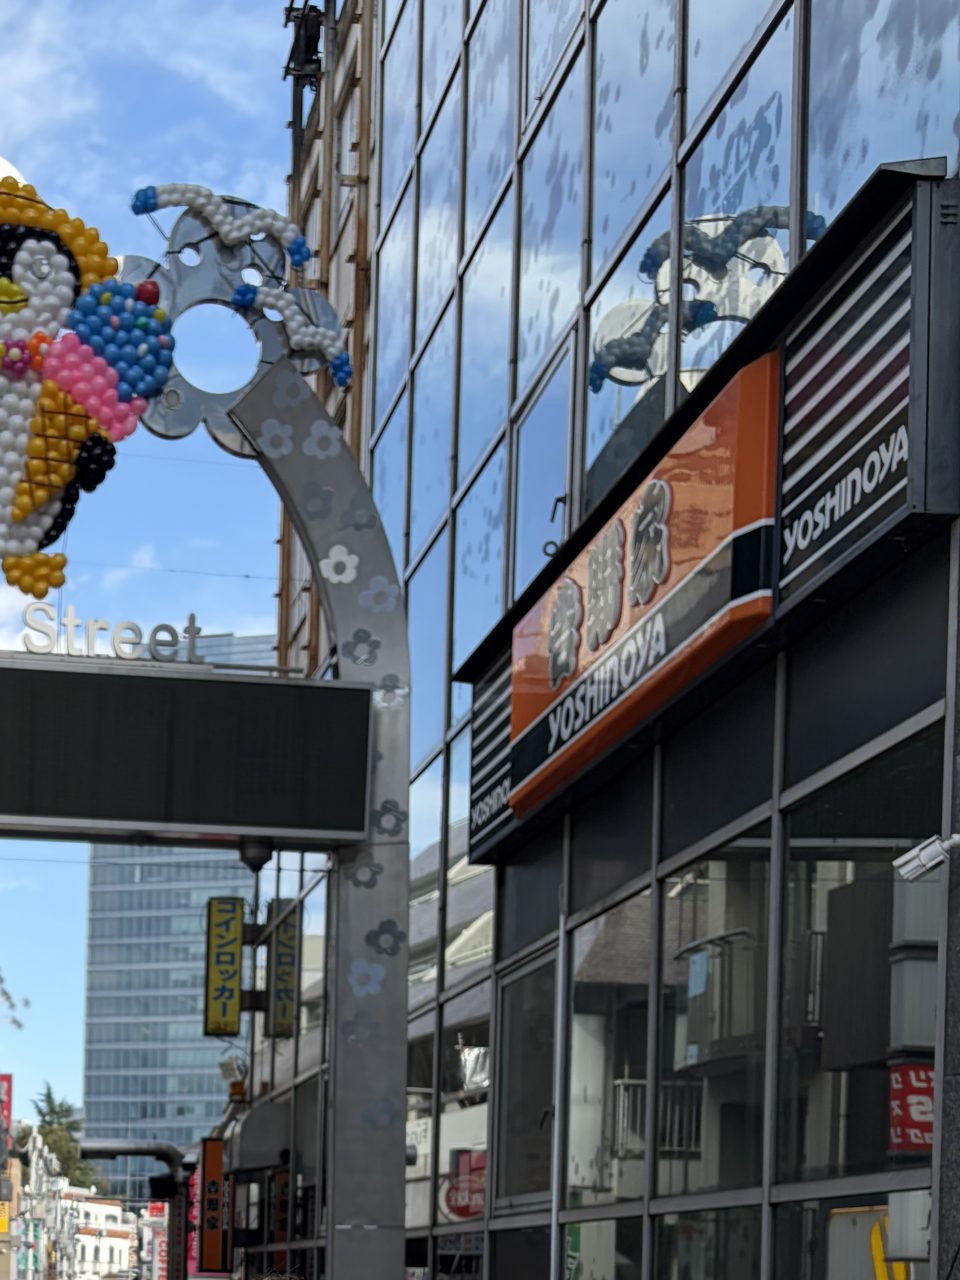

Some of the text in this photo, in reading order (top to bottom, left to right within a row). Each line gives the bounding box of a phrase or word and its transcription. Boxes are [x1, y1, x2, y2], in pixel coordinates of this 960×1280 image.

[783, 425, 908, 565] YOSHINOYA
[23, 600, 205, 664] Street
[547, 612, 666, 754] YOSHINOYA
[211, 901, 237, 1018] コインロッカー
